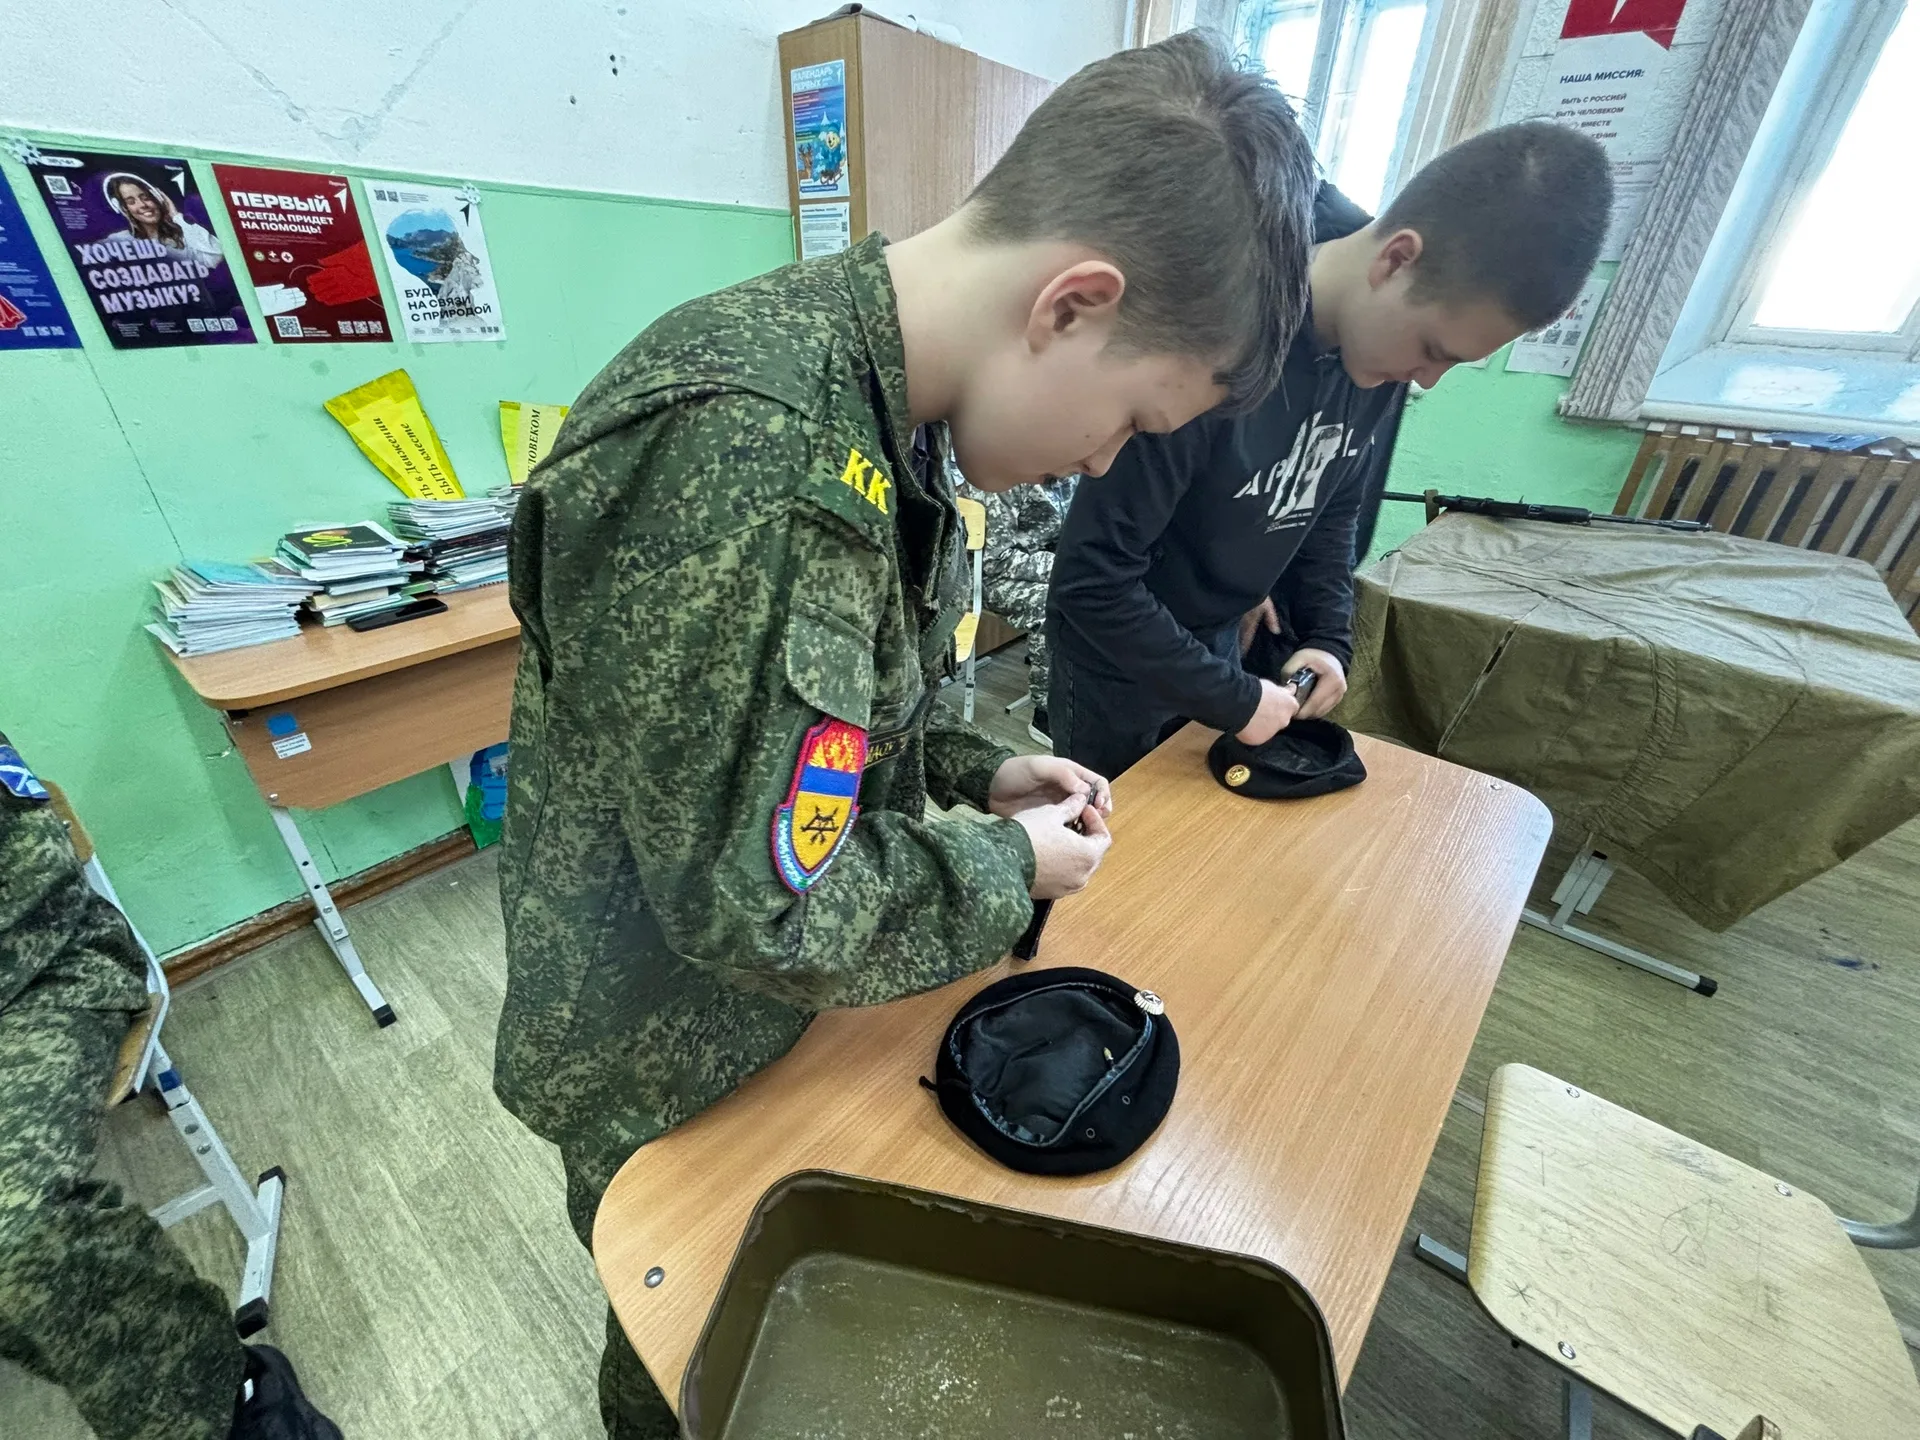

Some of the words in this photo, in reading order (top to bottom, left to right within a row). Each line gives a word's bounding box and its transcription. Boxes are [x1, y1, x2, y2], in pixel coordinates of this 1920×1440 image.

[1559, 72, 1594, 84] НАША
[1594, 68, 1645, 82] МИССИЯ:
[1589, 93, 1627, 103] РОССИЕЙ
[1577, 107, 1625, 116] ЧЕЛОВЕКОМ
[1581, 120, 1612, 128] ВМЕСТЕ
[230, 191, 331, 213] ПЕРВЫЙ
[238, 210, 286, 222] ВСЕГДА
[288, 214, 334, 225] ПРИДЕТ
[241, 220, 260, 230] НА
[261, 221, 322, 234] ПОМОЩЬ!
[75, 240, 167, 265] ХОЧЕШЬ
[88, 261, 209, 289] СОЗДАВАТЬ
[99, 284, 201, 314] МУЗЫКУ?
[408, 299, 427, 310] НА
[429, 295, 471, 308] СВЯЗИ
[411, 311, 420, 321] С
[423, 303, 492, 320] ПРИРОДОЙ
[373, 417, 421, 474] Движении
[400, 423, 431, 461] вместе
[528, 409, 541, 475] ЕЛОВЕКОМ
[428, 463, 454, 495] БЫТЬ
